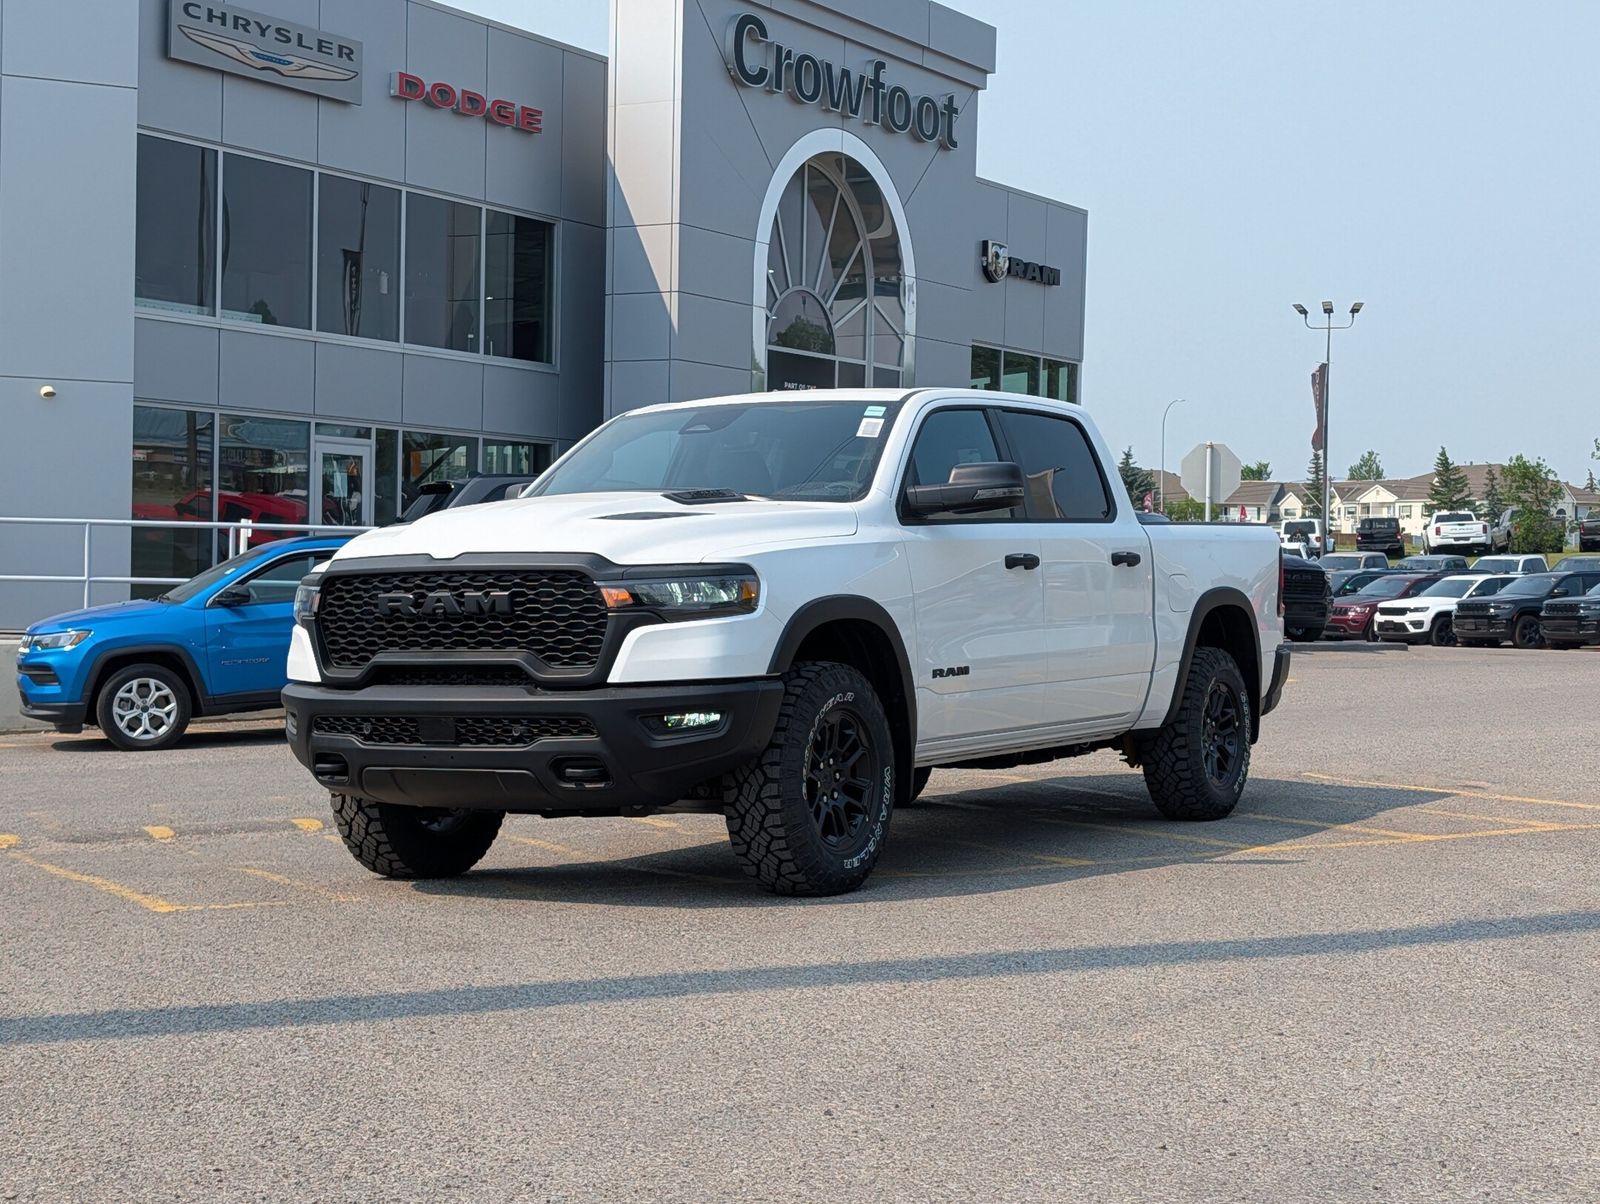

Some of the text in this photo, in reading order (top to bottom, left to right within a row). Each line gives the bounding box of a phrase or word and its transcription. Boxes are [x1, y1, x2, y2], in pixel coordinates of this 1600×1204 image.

[182, 1, 355, 63] CHRYSLER
[396, 70, 544, 134] DODGE
[731, 13, 960, 150] Crowfoot
[1007, 256, 1061, 287] RAM
[784, 381, 798, 390] PART
[377, 591, 513, 616] RAM
[931, 665, 970, 679] RAM
[843, 766, 892, 869] WRANGLER
